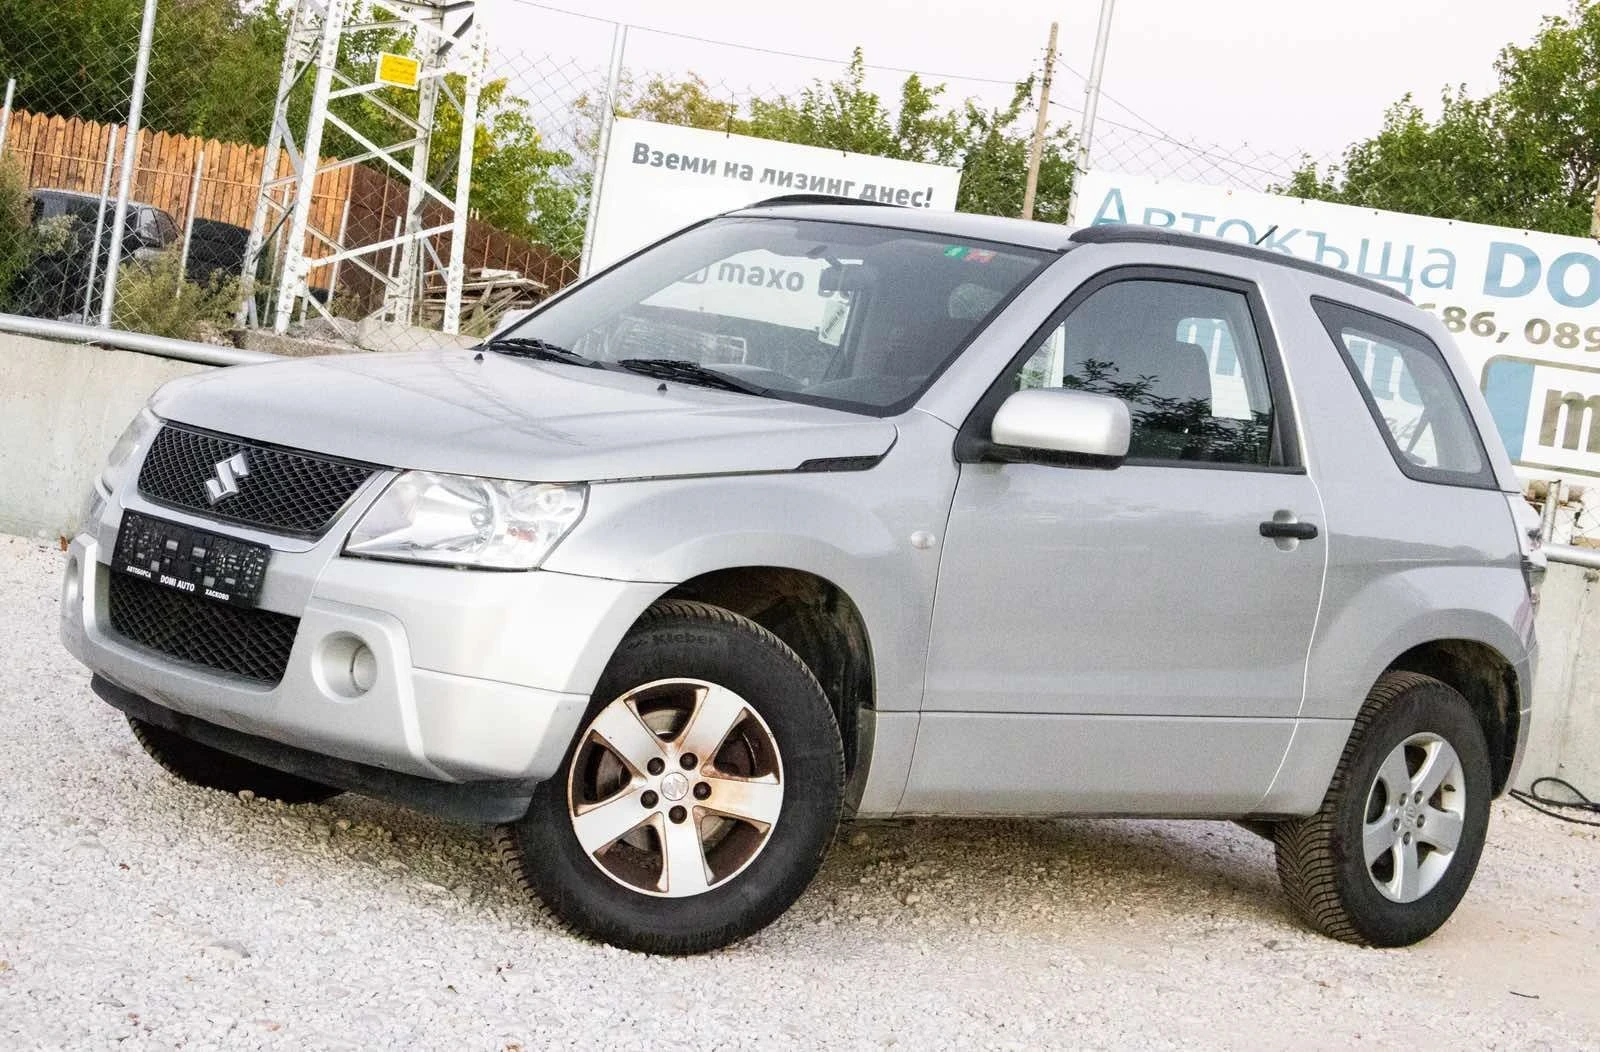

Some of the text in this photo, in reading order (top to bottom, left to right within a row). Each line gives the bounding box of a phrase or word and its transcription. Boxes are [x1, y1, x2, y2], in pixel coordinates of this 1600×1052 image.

[632, 142, 933, 208] Вземи на лизинг днес!
[1418, 303, 1509, 344] 86,
[160, 574, 195, 592] DOMI AUTO
